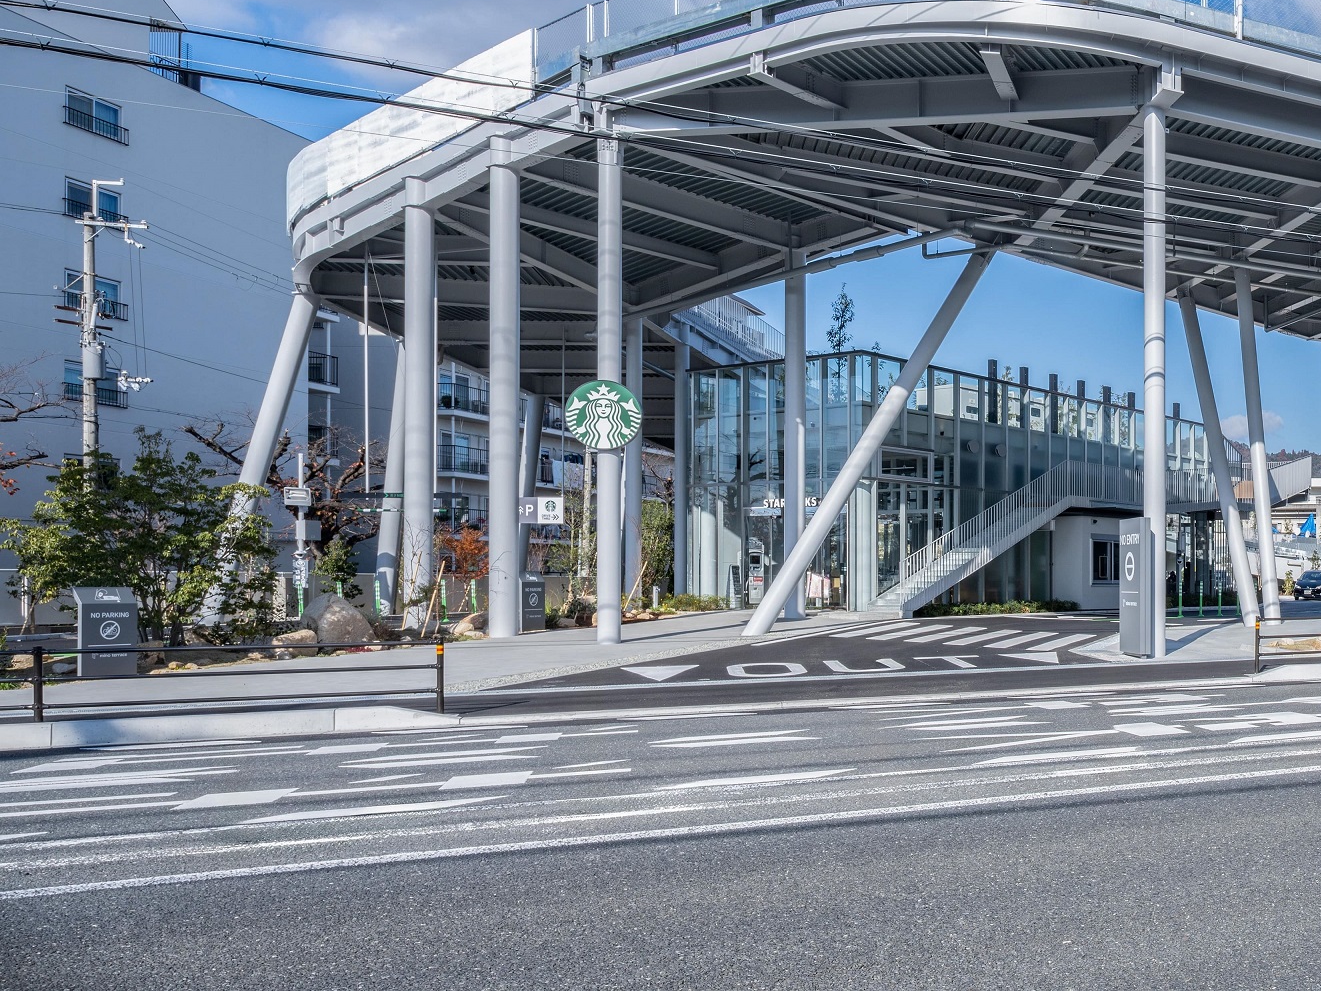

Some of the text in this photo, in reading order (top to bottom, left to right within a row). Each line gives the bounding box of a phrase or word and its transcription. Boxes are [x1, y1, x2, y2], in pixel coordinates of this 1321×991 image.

[763, 496, 817, 508] STARKS
[525, 504, 534, 516] P
[1120, 533, 1139, 546] NO ENTRY
[726, 654, 979, 678] OUT
